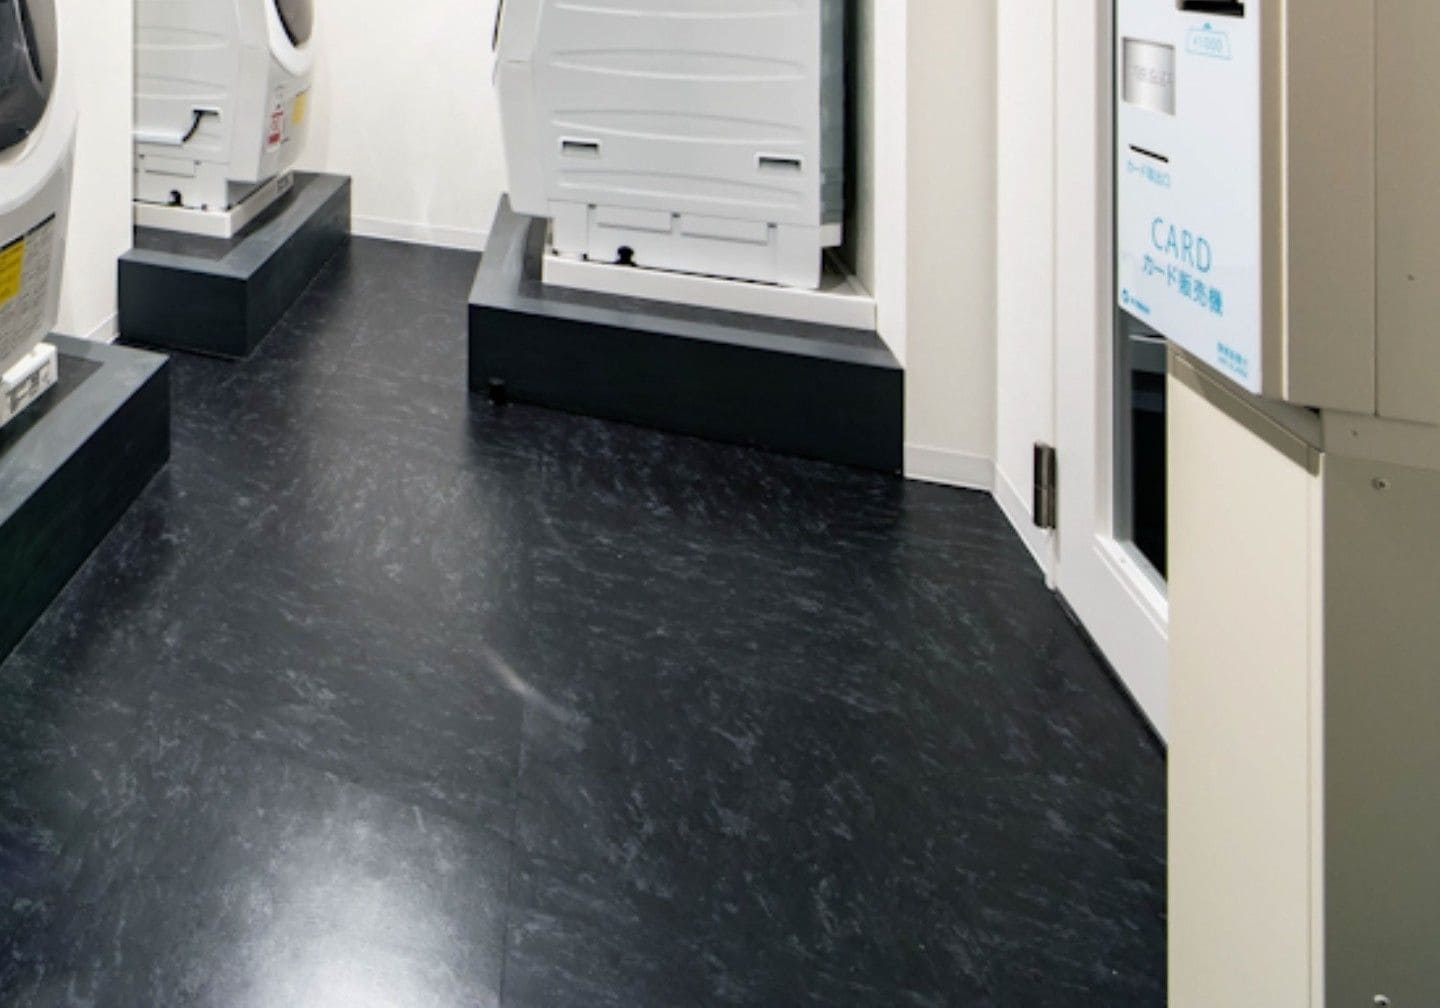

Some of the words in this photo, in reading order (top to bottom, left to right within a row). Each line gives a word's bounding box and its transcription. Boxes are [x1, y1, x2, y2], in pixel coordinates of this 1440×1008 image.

[1151, 217, 1212, 272] CARD
[1143, 254, 1223, 316] カード販売機
